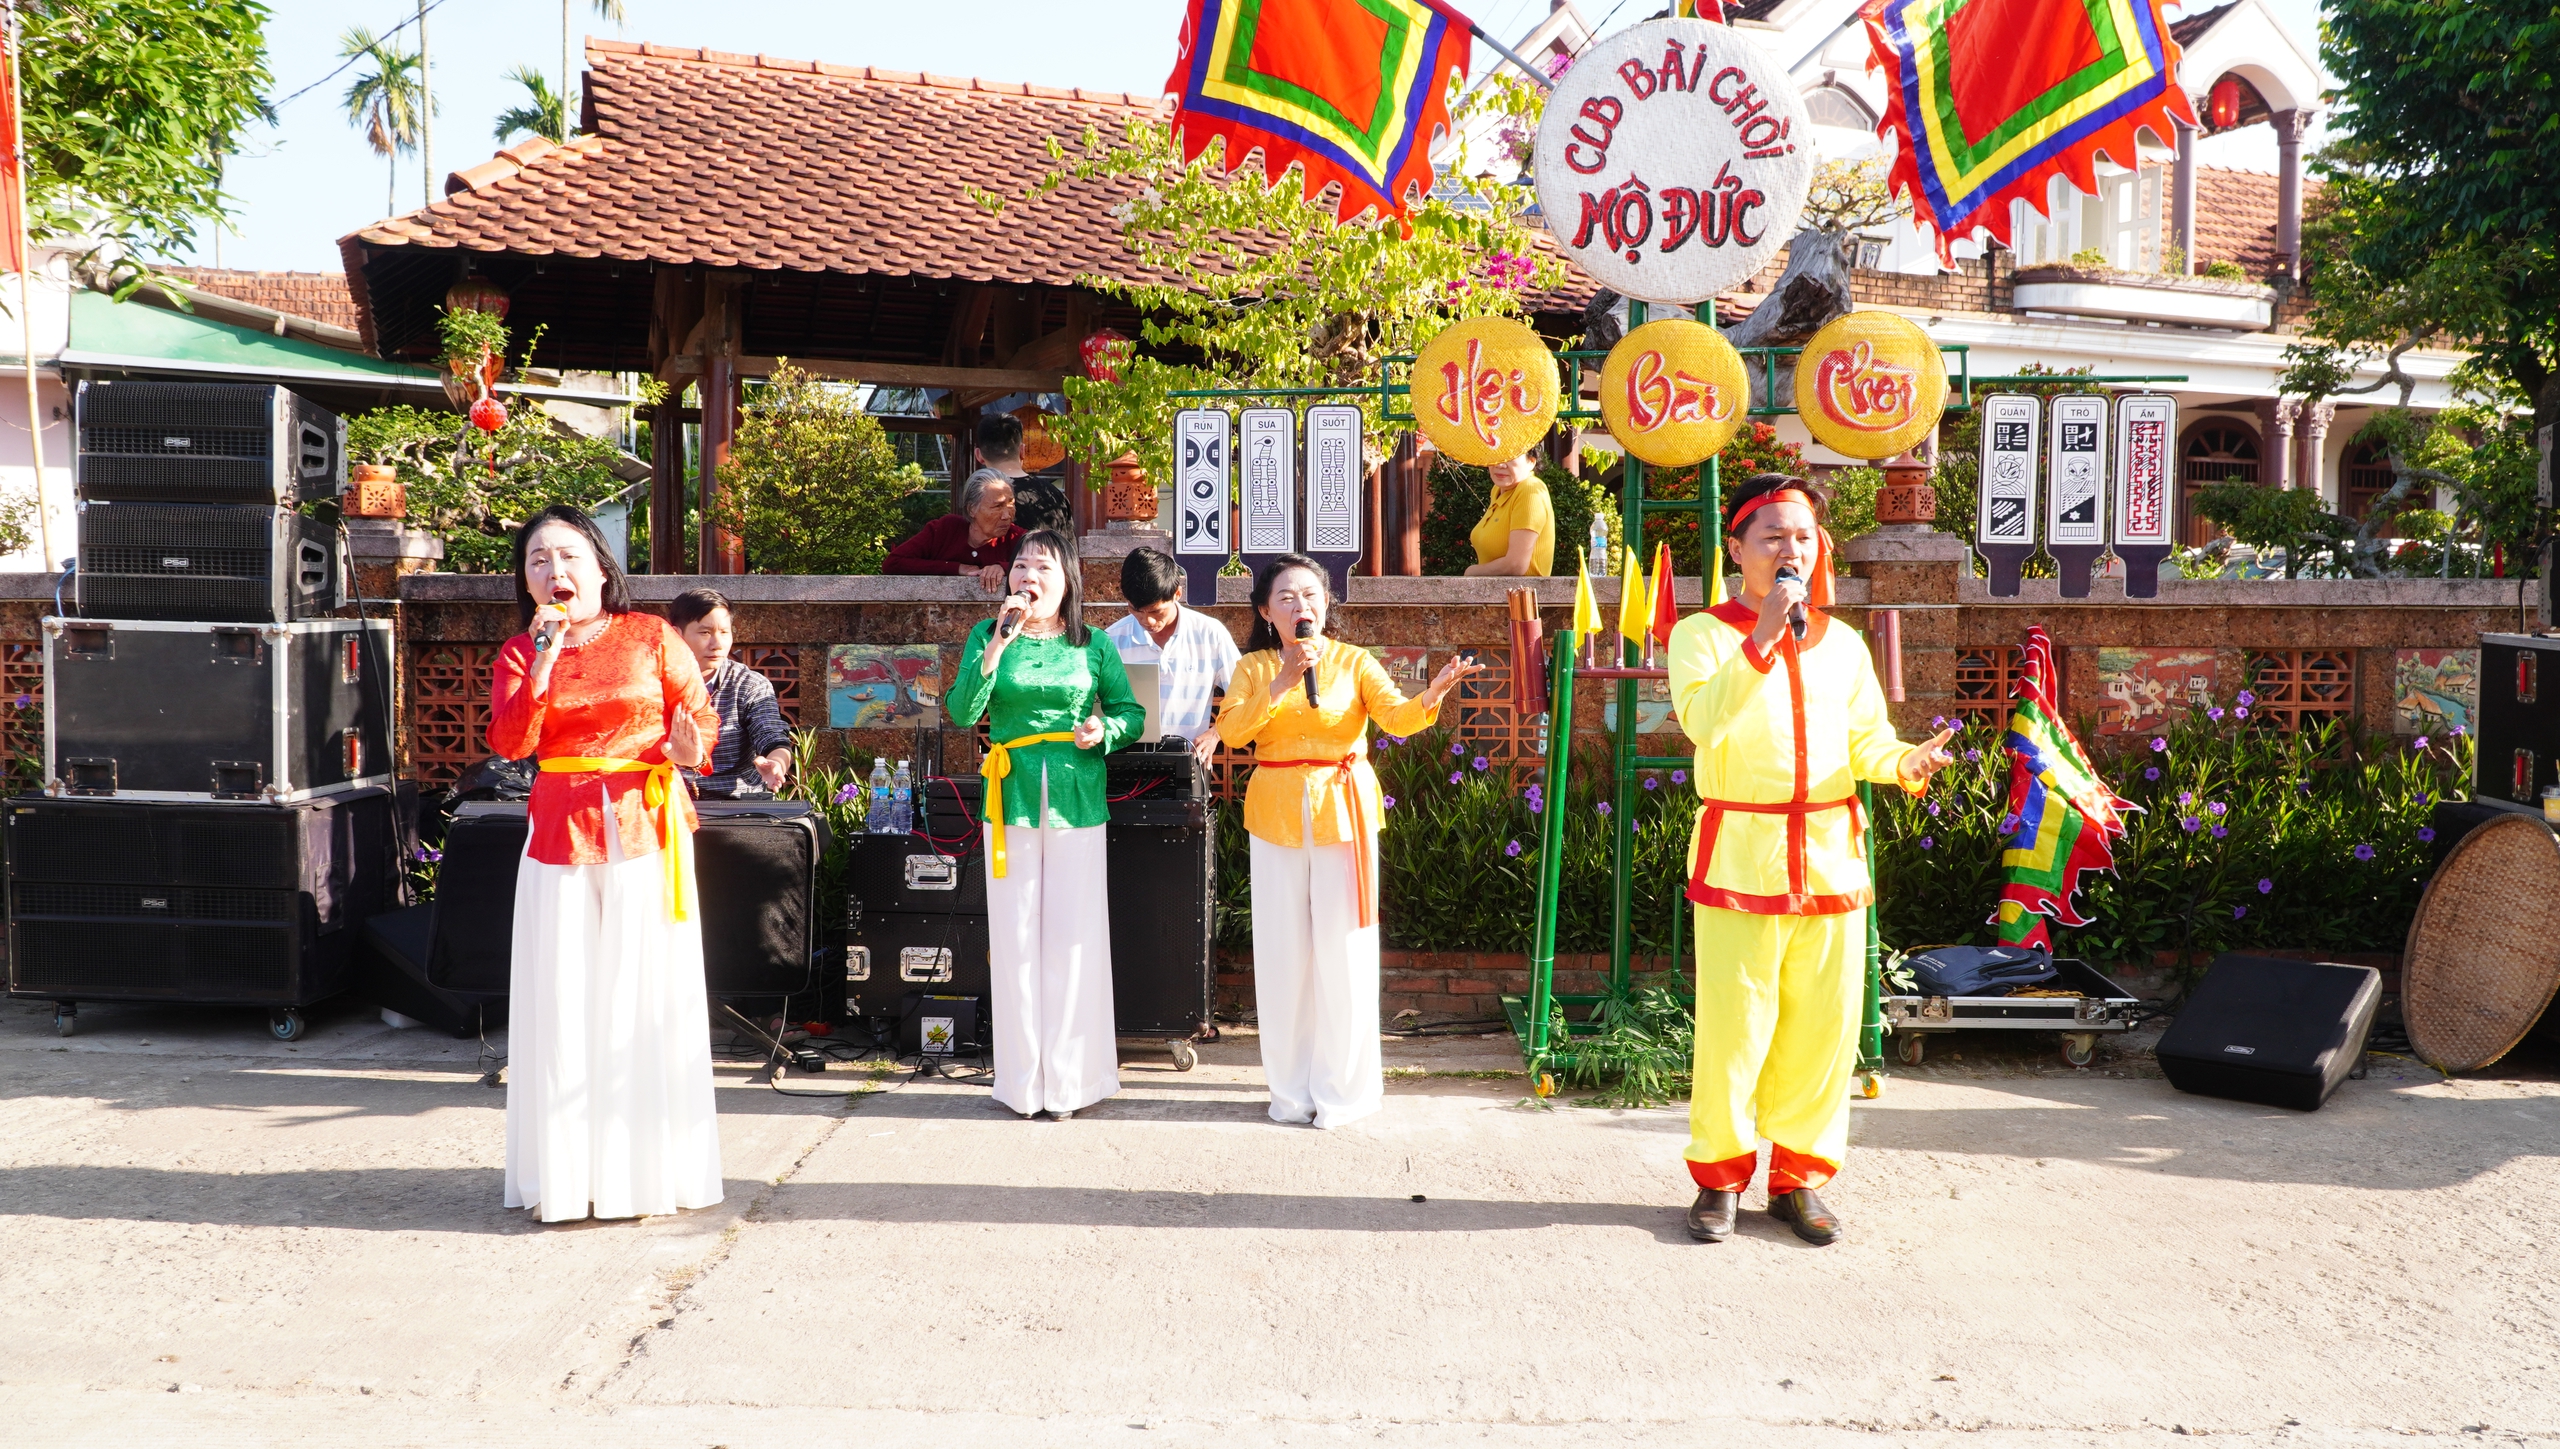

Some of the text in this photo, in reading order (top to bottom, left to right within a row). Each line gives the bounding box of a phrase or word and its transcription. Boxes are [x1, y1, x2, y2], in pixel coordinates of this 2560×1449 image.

[1564, 95, 1623, 175] CLB
[1616, 38, 1708, 101] BÀI
[1571, 159, 1769, 265] MỘ ĐỨC
[1436, 338, 1542, 450] Hội
[1626, 349, 1735, 434] Bài
[2070, 406, 2090, 417] TRÒ
[1193, 420, 1213, 430] RÚN
[1257, 419, 1276, 429] SƯA
[1322, 415, 1346, 427] SUỐT
[1586, 657, 1592, 667] 1
[1616, 657, 1624, 667] 2
[1646, 657, 1654, 667] 3
